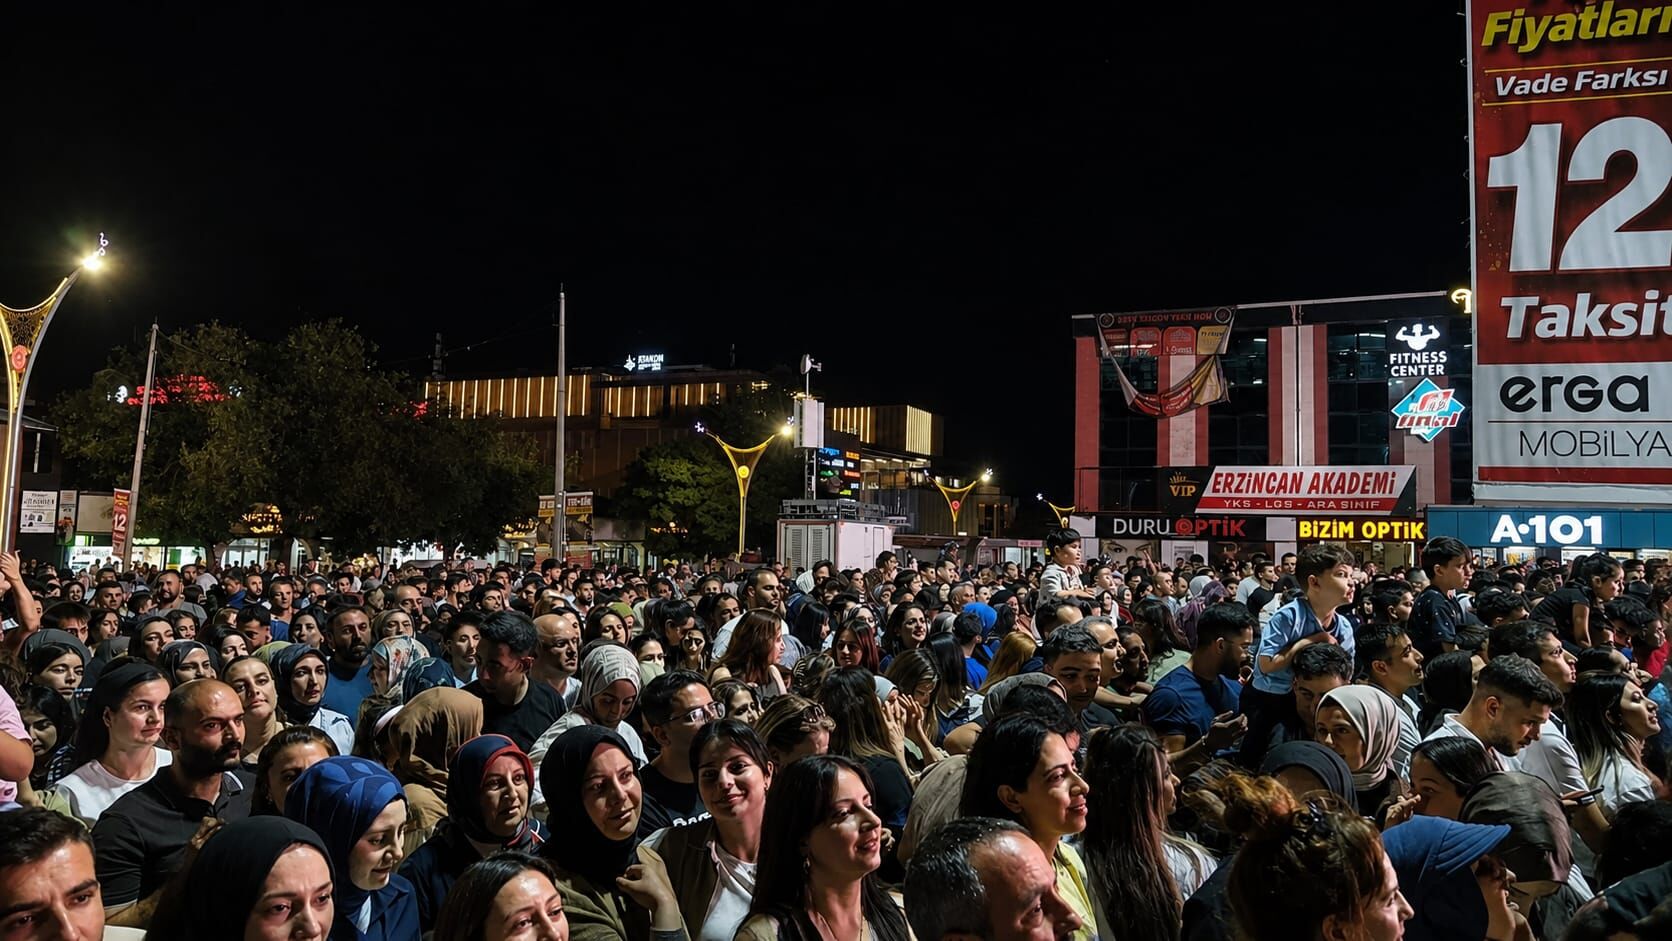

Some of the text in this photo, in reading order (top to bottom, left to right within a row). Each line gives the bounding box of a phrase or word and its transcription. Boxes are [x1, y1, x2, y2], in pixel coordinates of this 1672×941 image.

[1495, 67, 1668, 97] Vade Farksı
[1487, 116, 1672, 272] 12
[1390, 351, 1447, 364] FITNESS
[1391, 364, 1445, 377] CENTER
[1169, 485, 1196, 497] VIP
[1223, 500, 1251, 508] YKS
[1265, 500, 1292, 508] LGS
[1307, 500, 1337, 509] ARA
[1340, 501, 1380, 509] SINIF
[113, 513, 127, 531] 12
[1113, 518, 1170, 535] DURU
